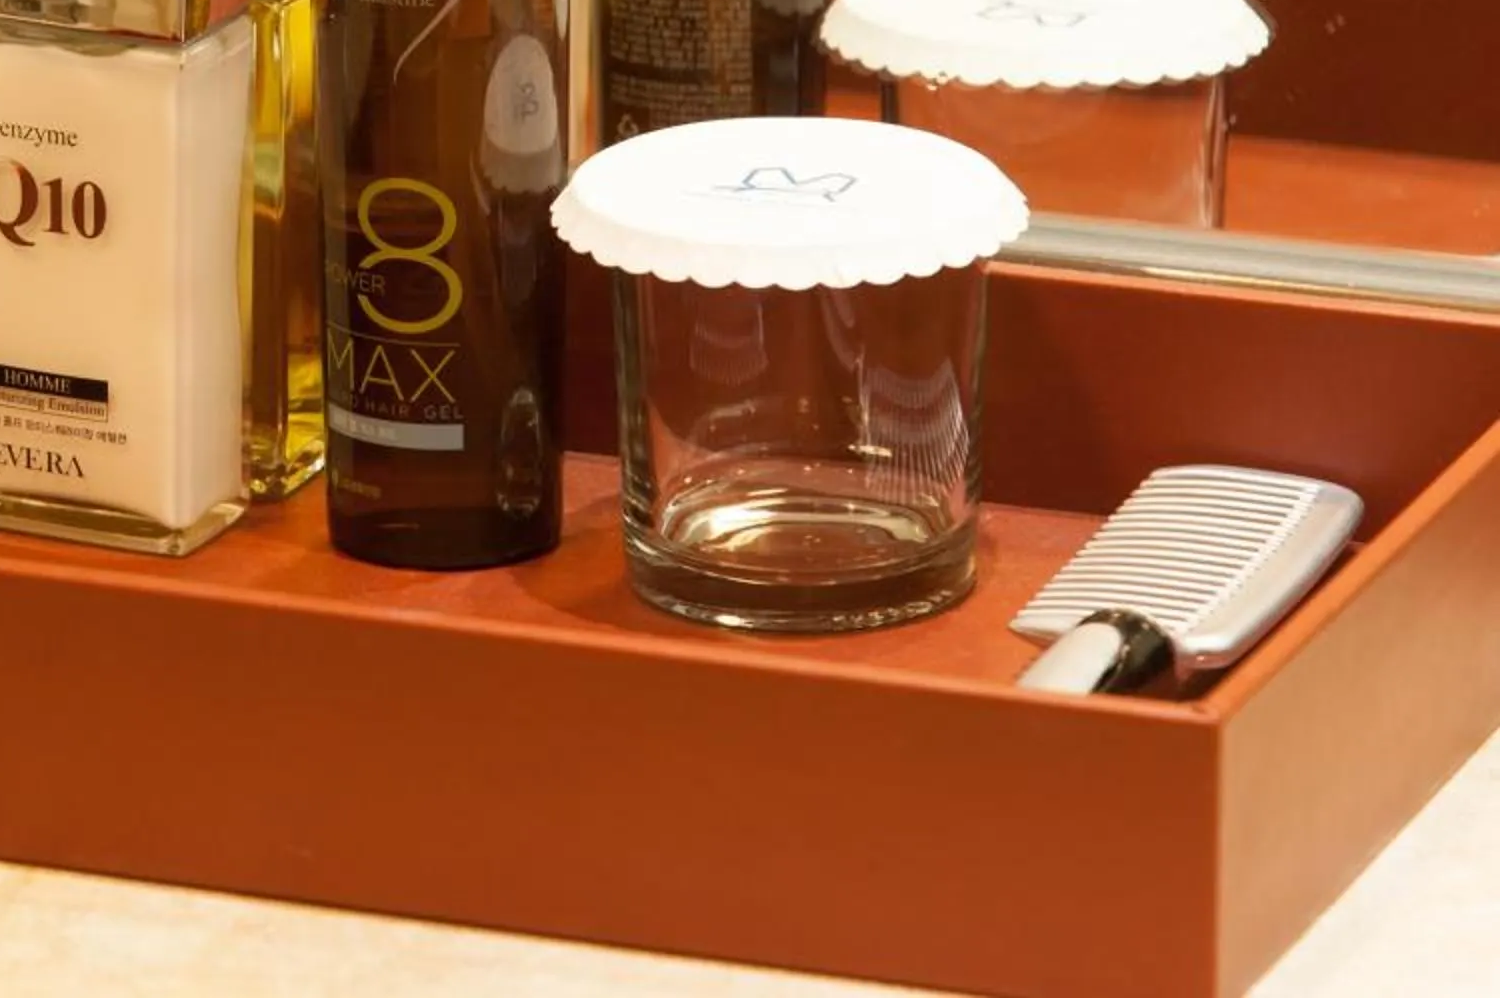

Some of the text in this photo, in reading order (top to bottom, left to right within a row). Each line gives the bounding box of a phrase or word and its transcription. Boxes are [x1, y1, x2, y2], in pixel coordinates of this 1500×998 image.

[357, 178, 464, 335] 8
[3, 368, 72, 395] HOMME
[326, 329, 457, 404] MAX
[422, 403, 465, 421] GEL
